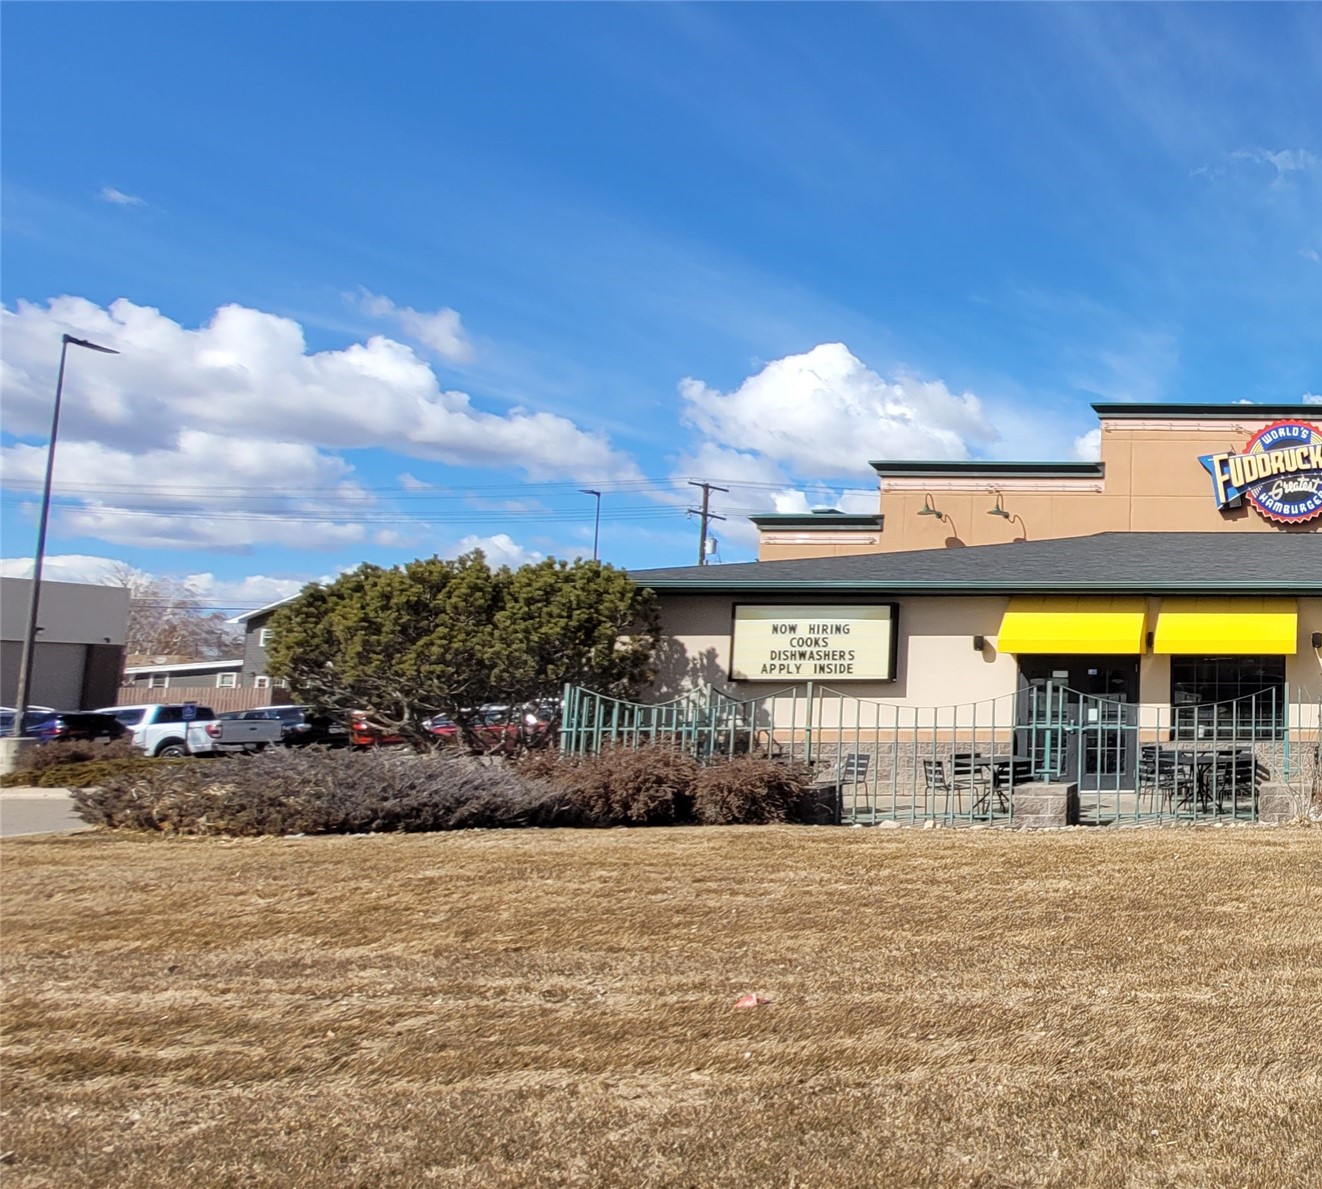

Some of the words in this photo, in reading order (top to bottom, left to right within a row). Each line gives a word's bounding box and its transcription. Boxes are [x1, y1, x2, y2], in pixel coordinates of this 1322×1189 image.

[1261, 427, 1309, 444] WORLD'S
[1269, 476, 1322, 500] Greatest
[772, 624, 797, 634] NOW
[809, 624, 850, 634] HIRING
[790, 637, 829, 648] COOKS
[770, 650, 855, 661] DISHWASHERS
[761, 663, 802, 674] APPLY
[814, 663, 853, 674] INSIDE
